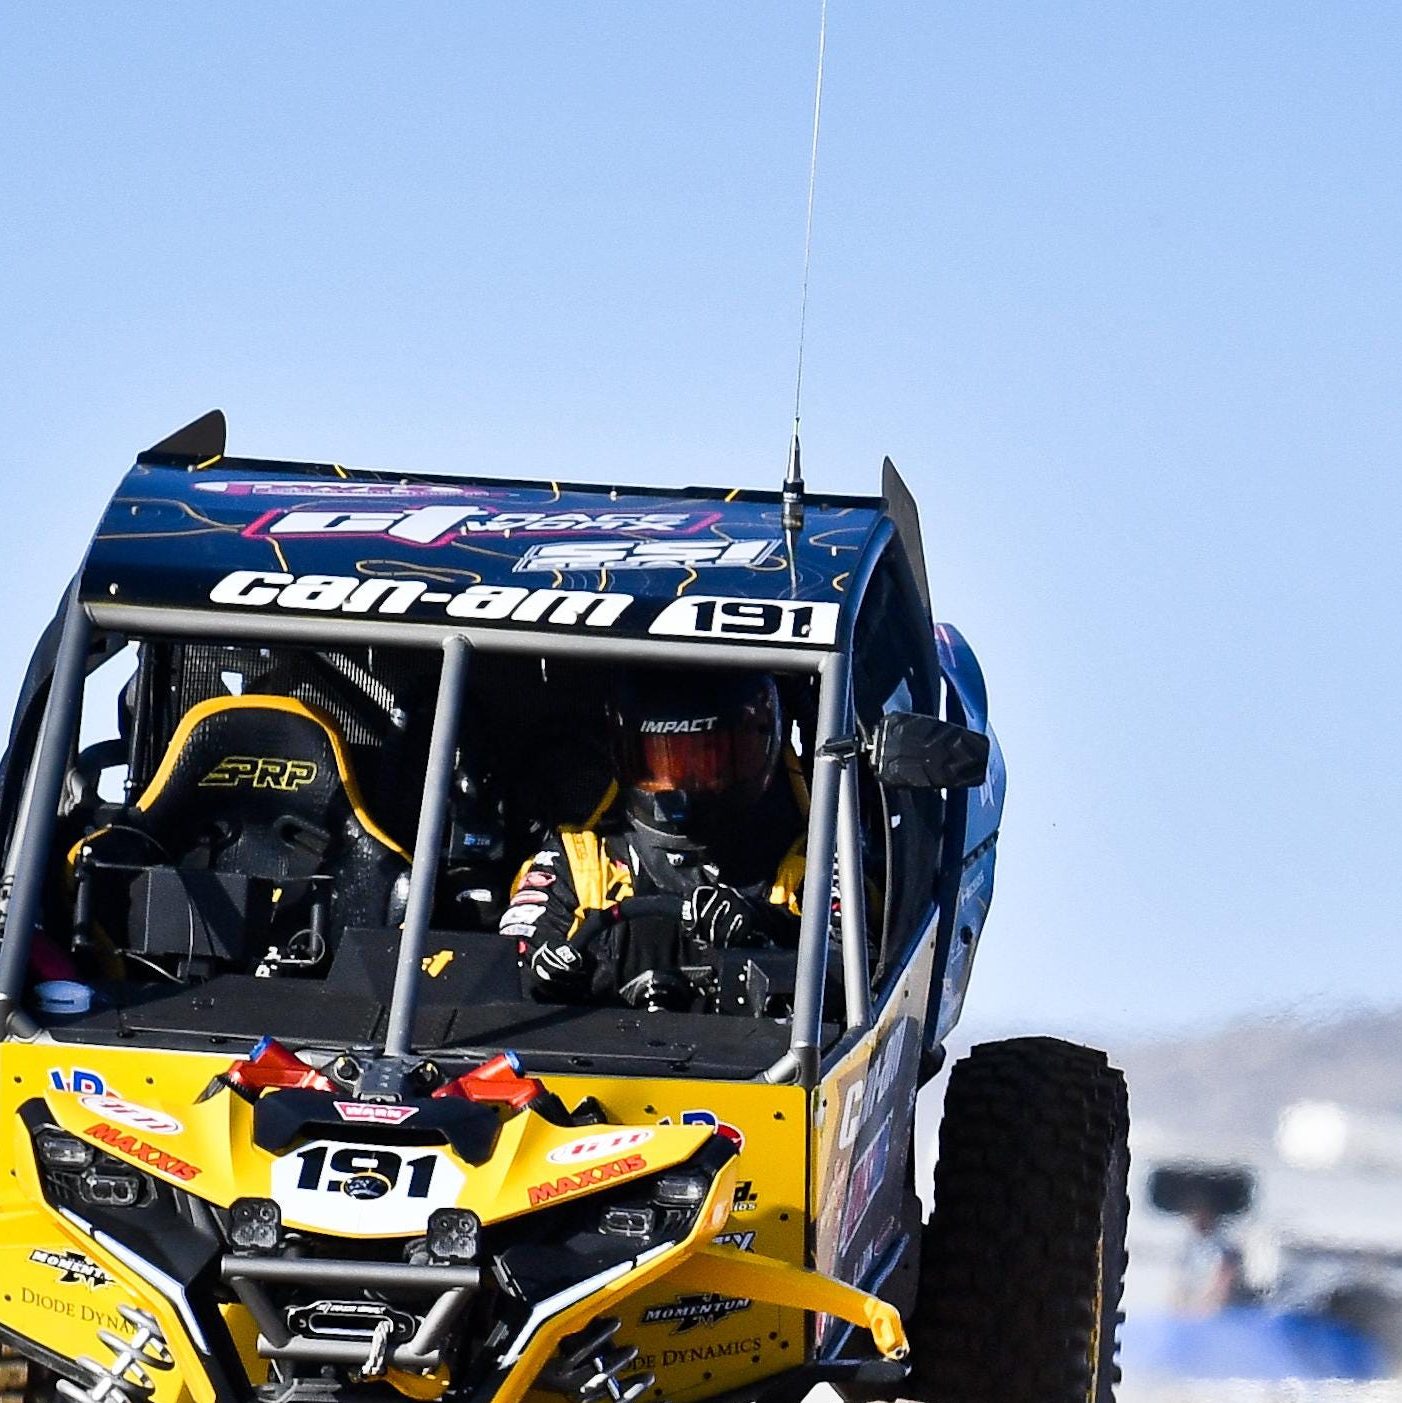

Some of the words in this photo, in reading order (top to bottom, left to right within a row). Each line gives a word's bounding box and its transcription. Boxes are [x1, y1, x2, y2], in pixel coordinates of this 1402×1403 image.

[209, 570, 635, 627] can-am
[692, 600, 814, 638] 191
[640, 716, 719, 734] IMPACT
[203, 755, 318, 791] PRP
[345, 1105, 403, 1121] WARN
[84, 1122, 203, 1181] MAXXIS
[297, 1145, 438, 1199] 191
[529, 1153, 647, 1206] MAXXIS
[21, 1287, 76, 1317] DIODE
[81, 1305, 137, 1335] DYNA
[647, 1296, 749, 1321] MOMENTUM
[662, 1337, 762, 1366] DYNAMICS
